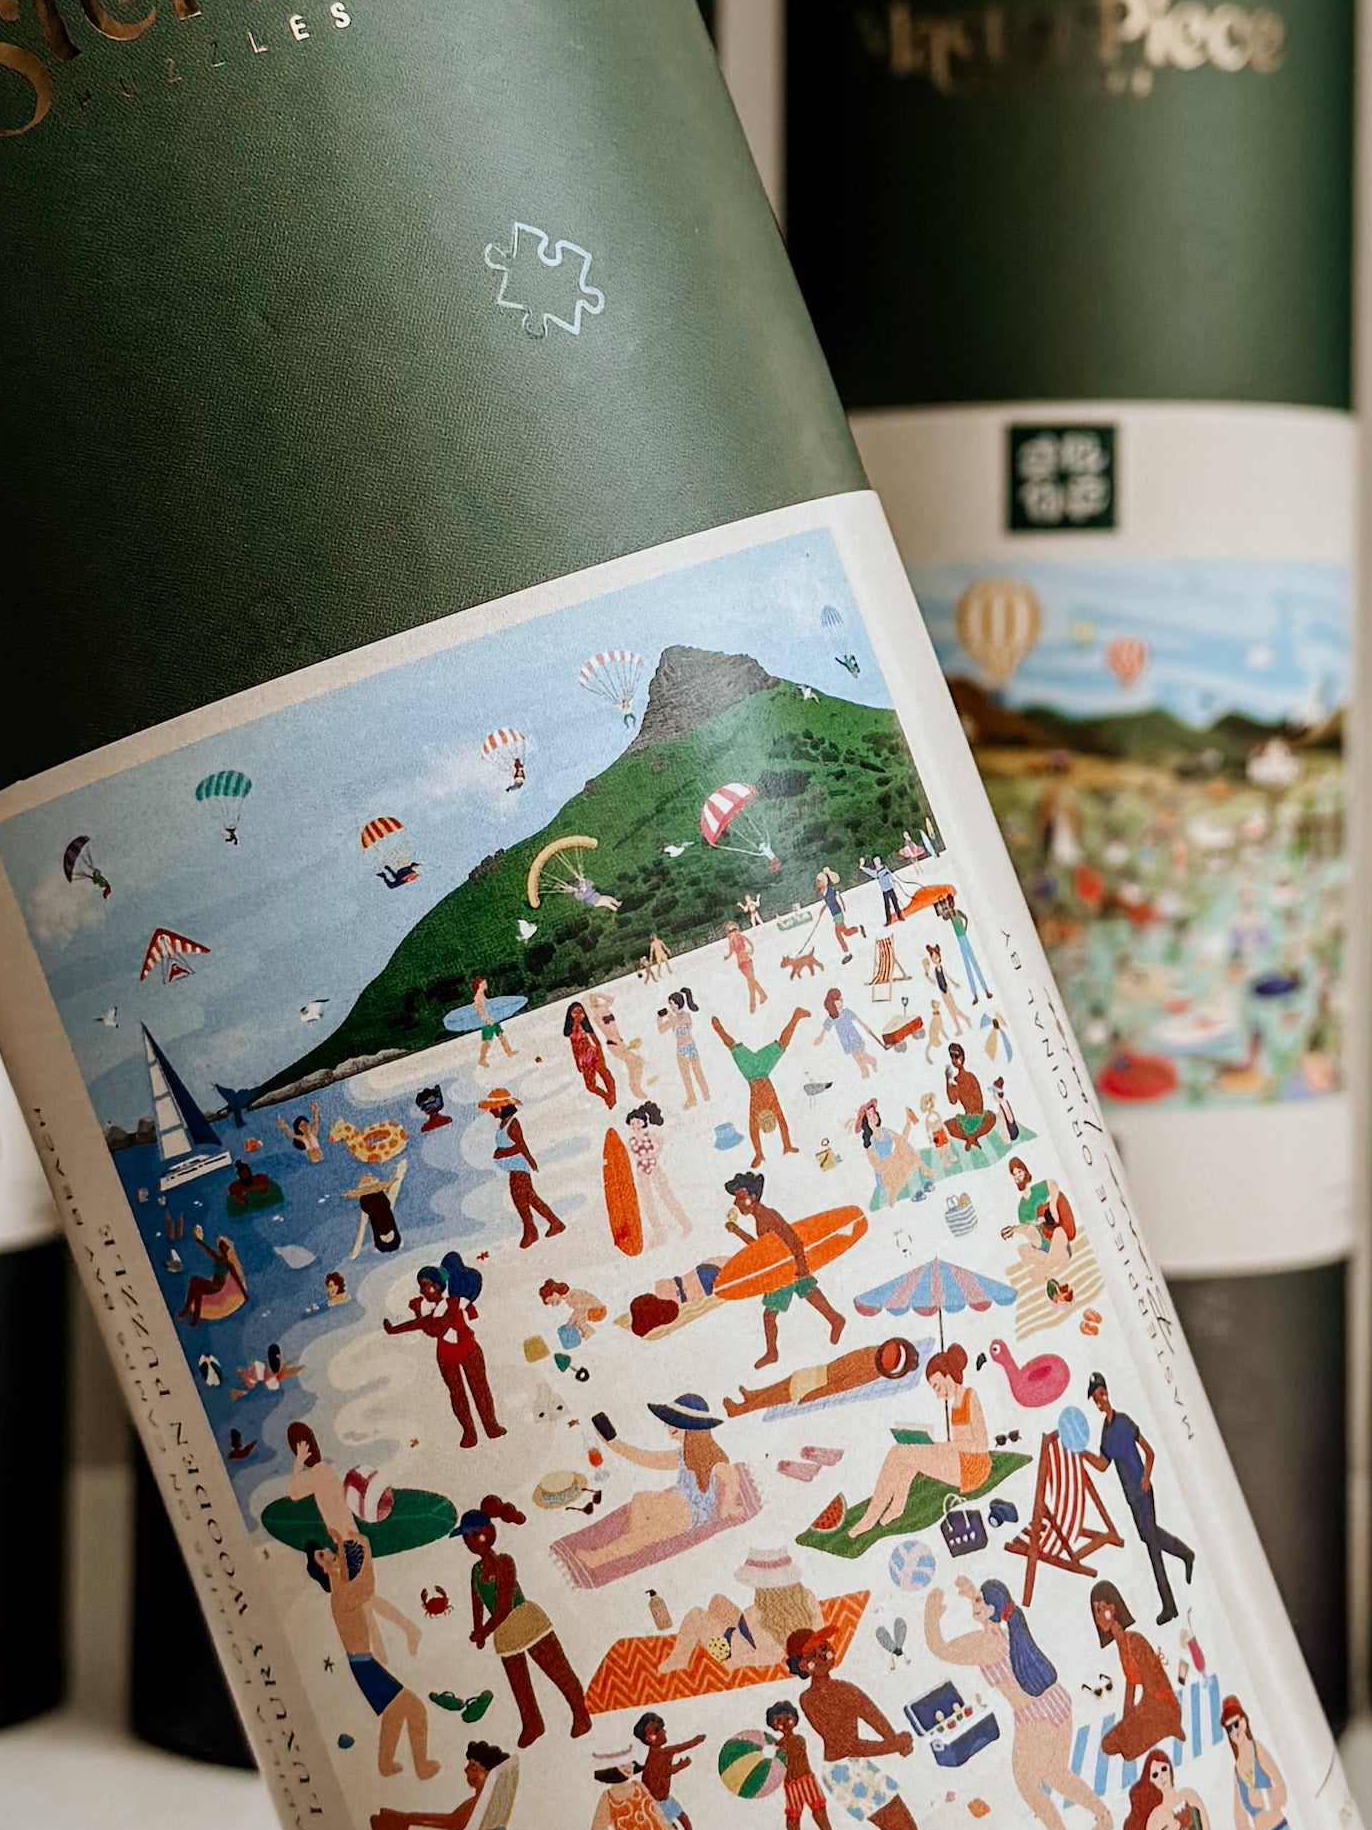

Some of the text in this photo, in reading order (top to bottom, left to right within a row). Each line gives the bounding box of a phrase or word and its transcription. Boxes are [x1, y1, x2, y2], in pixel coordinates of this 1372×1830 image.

[33, 1107, 84, 1226] BEACH
[999, 928, 1195, 1441] MASTERPIECE ORIGINAL BY
[85, 1245, 115, 1311] BAY
[97, 1223, 324, 1814] LUXURY WOODEN PUZZLE
[169, 1473, 192, 1521] ON
